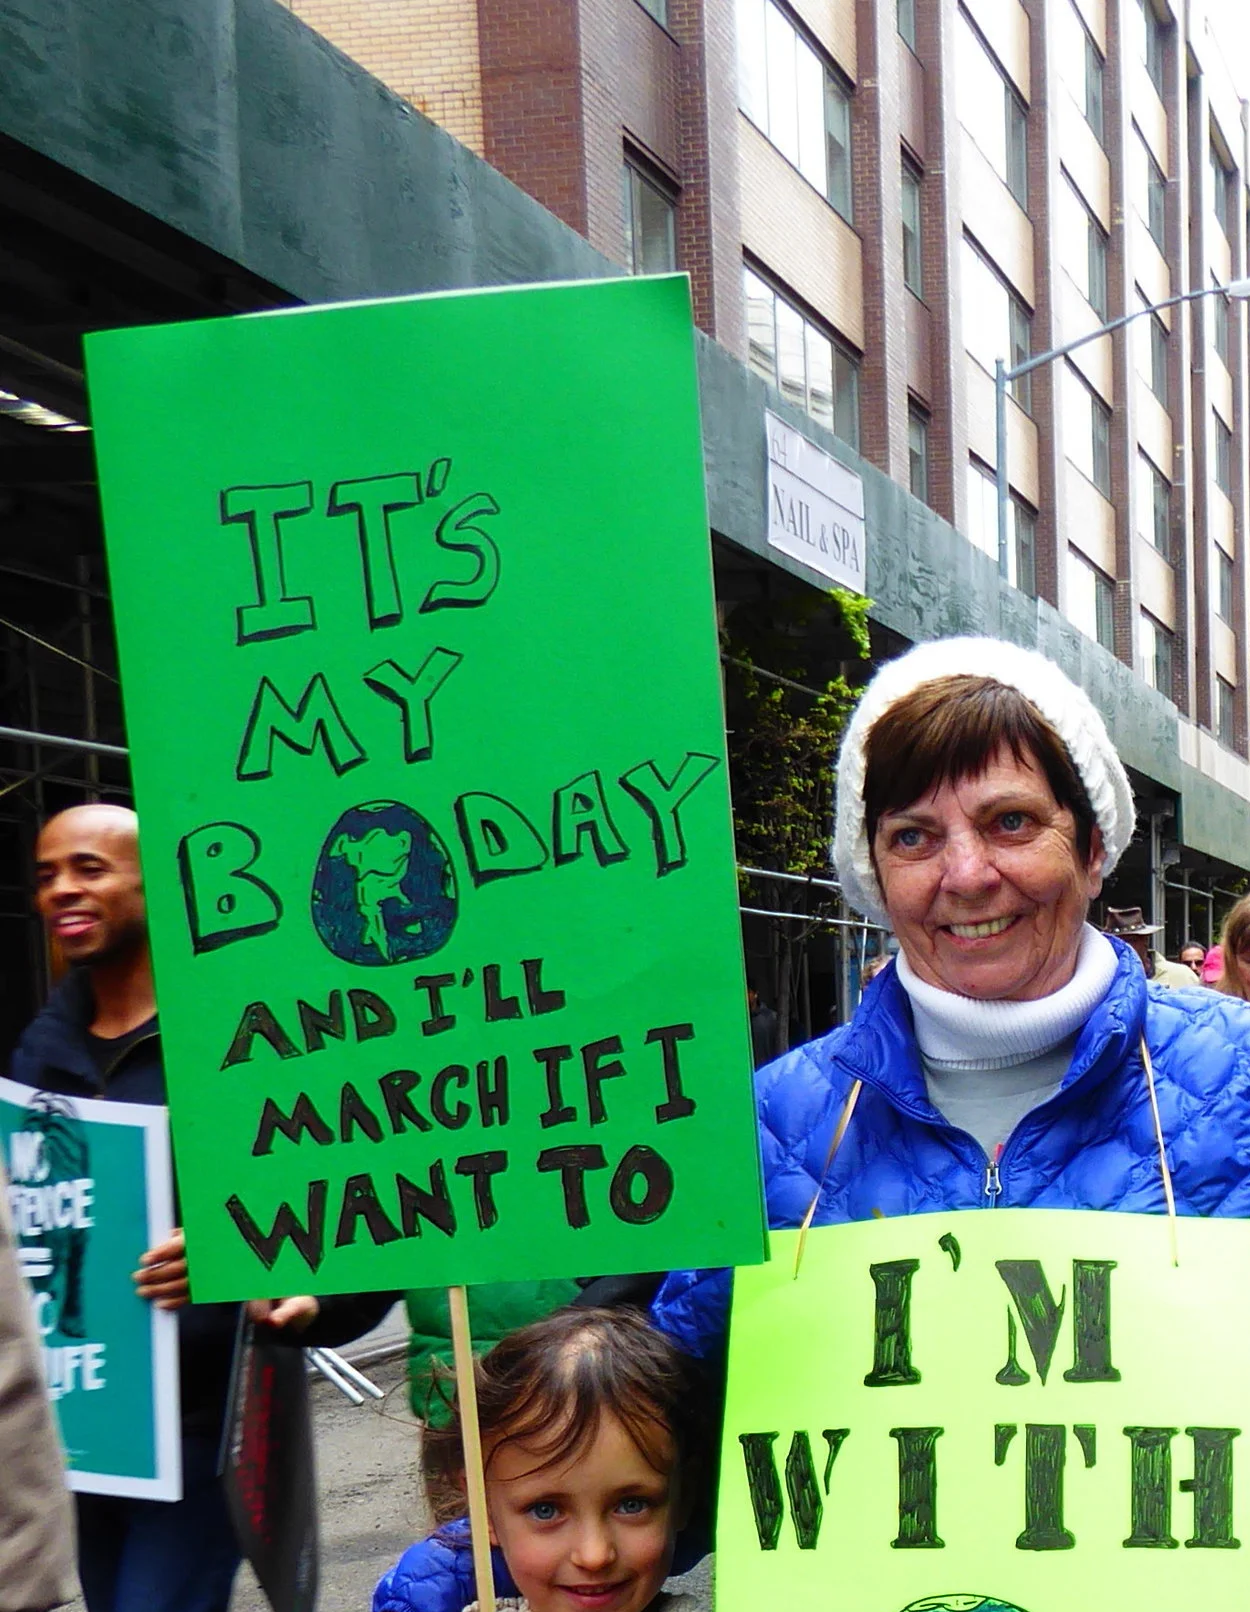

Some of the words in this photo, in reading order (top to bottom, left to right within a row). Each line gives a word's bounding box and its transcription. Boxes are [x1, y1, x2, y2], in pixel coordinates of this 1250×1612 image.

[219, 457, 502, 647] IT'S
[772, 482, 816, 547] NAIL
[818, 523, 829, 554] &
[832, 522, 861, 573] SPA
[236, 646, 464, 781] MY
[220, 989, 398, 1071] AND
[414, 958, 566, 1036] I'LL
[251, 1055, 510, 1157] MARCH
[533, 1035, 628, 1128] IF
[643, 1022, 697, 1124] I
[225, 1149, 509, 1275] WANT
[536, 1144, 674, 1225] TO
[863, 1231, 1123, 1387] I'M
[738, 1424, 1243, 1552] WITH
